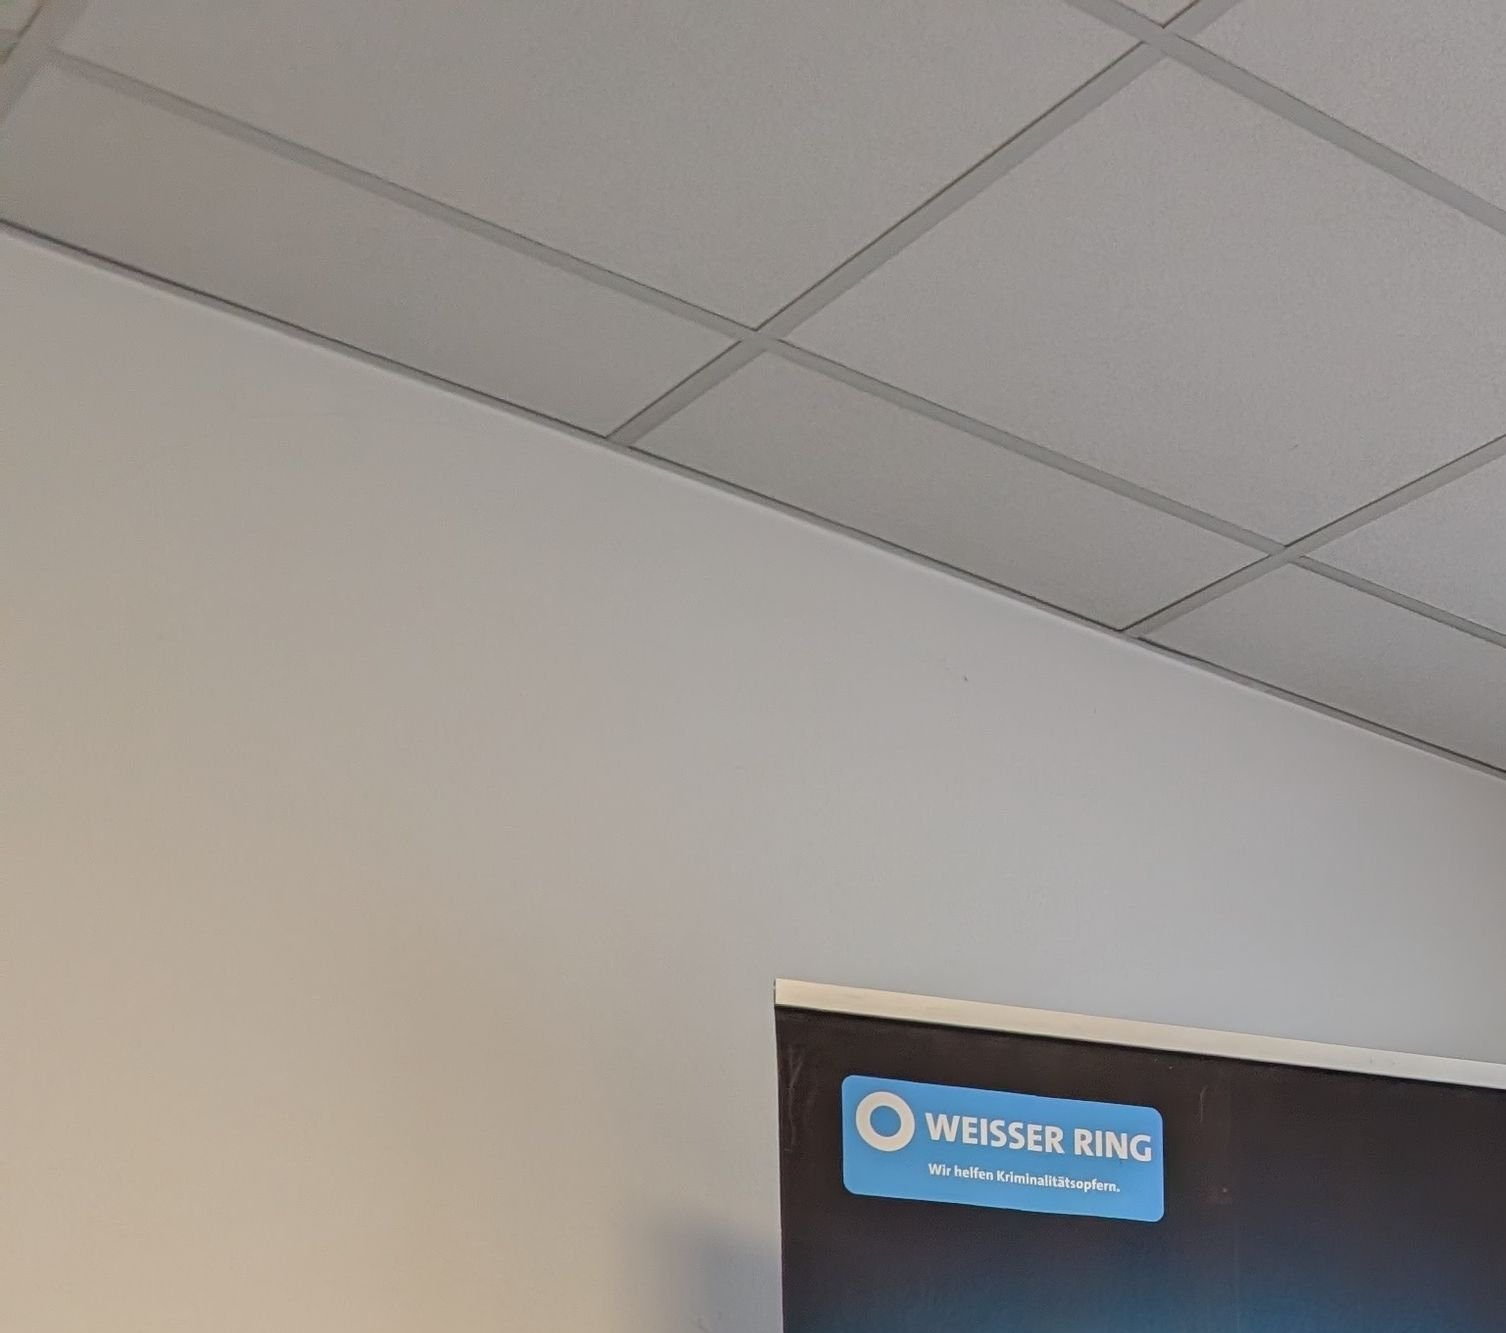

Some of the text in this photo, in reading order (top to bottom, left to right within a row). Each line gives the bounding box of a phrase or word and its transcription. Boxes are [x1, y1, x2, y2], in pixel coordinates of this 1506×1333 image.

[925, 1112, 1152, 1162] WEISSER RING
[928, 1163, 1121, 1193] Wir helfen Kriminalitätsopfern.
